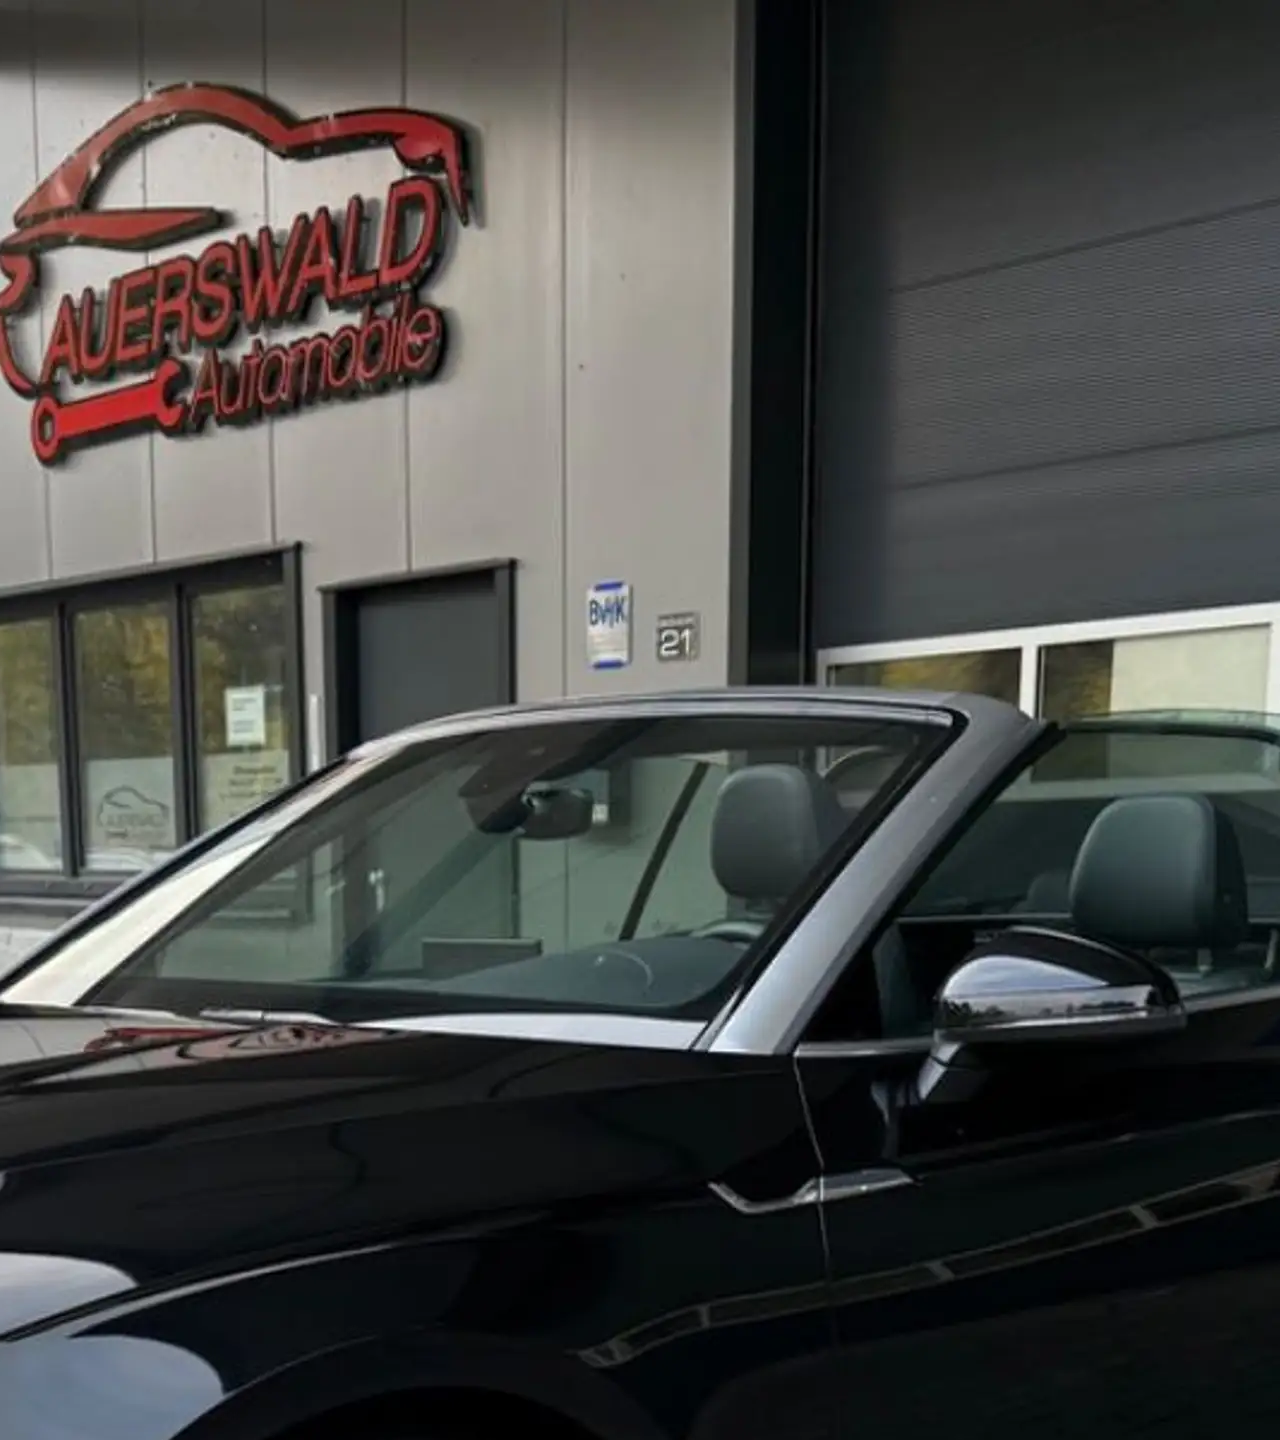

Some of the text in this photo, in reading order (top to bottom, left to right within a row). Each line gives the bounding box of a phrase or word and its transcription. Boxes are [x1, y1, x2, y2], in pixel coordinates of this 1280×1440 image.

[40, 176, 443, 389] AUERSWALD
[189, 298, 441, 418] Automobile
[660, 628, 691, 657] 21
